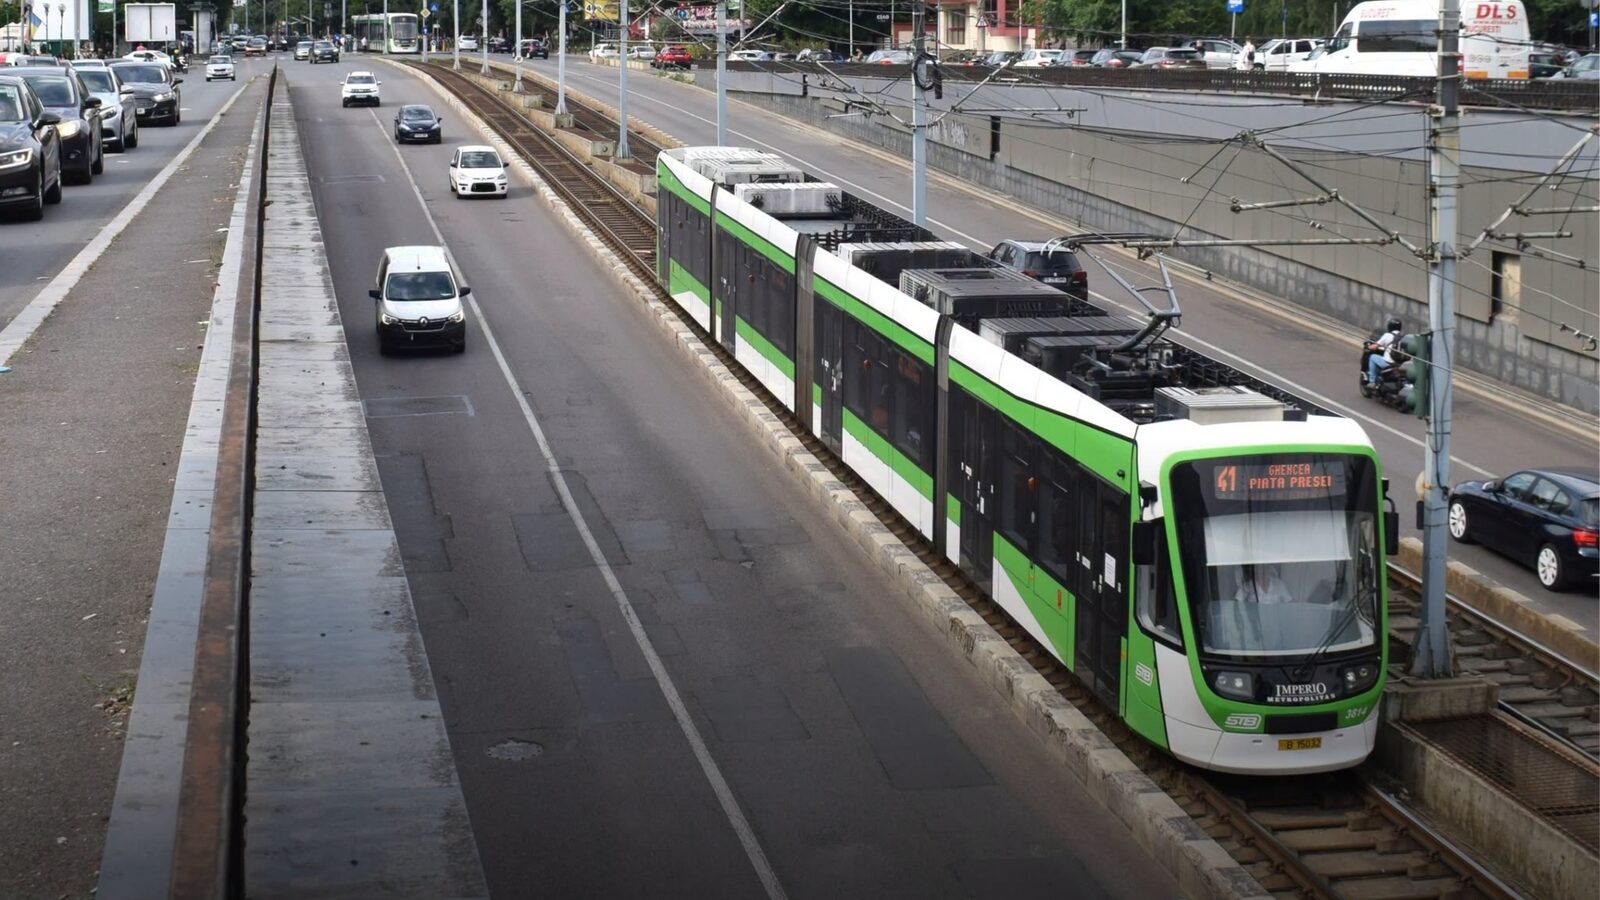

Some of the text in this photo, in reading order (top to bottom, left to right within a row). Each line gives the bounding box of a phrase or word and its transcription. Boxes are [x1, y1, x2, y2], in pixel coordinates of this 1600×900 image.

[1268, 463, 1311, 476] GHENCEA
[1217, 465, 1237, 492] 41
[1249, 475, 1332, 489] PIATA PRESEI
[1276, 682, 1326, 696] IMPERIO
[1267, 694, 1336, 702] METROPOLITAN
[1345, 706, 1368, 719] 3814
[1225, 715, 1259, 727] STB
